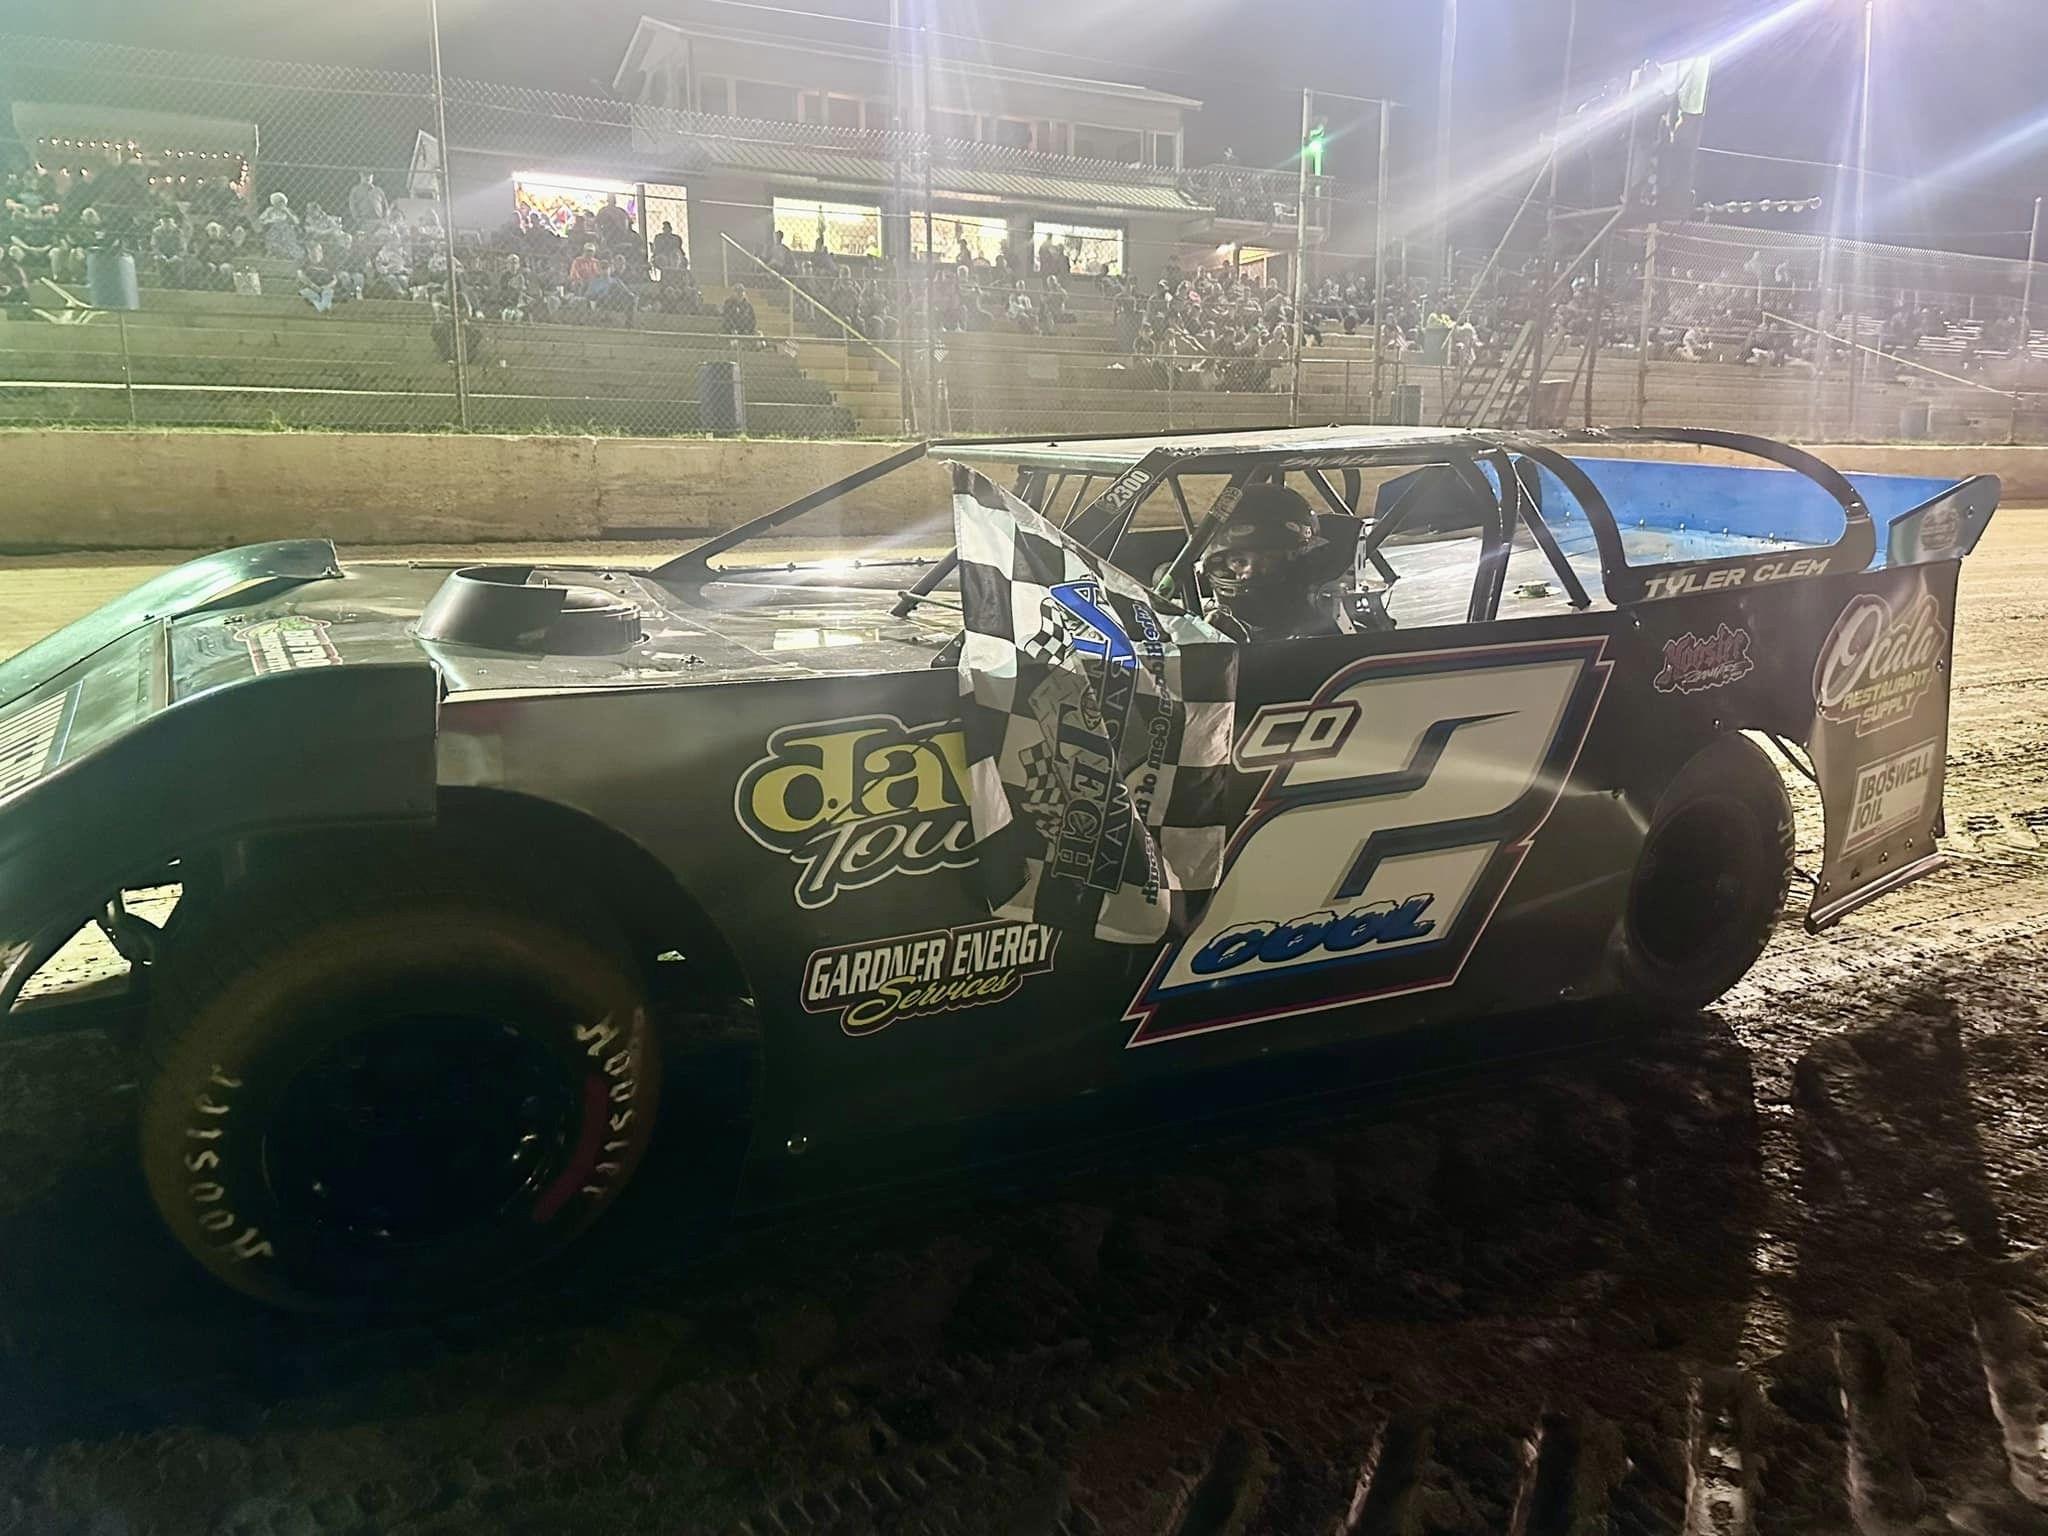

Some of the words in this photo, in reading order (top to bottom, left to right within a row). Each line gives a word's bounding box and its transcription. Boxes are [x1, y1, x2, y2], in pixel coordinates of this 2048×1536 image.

[1105, 469, 1151, 508] 2300
[1645, 568, 1747, 598] TYLER
[1752, 558, 1832, 583] CLEM
[1821, 602, 1937, 707] Ocala
[1841, 667, 1931, 712] RESTAURANT
[1861, 693, 1914, 725] SUPPLY
[1241, 705, 1356, 759] CO
[1864, 751, 1929, 802] BOSWELL
[1160, 659, 1585, 990] 2
[1858, 796, 1883, 829] OIL
[1190, 892, 1436, 976] COOL
[807, 937, 947, 1002] GARDNER
[951, 922, 1056, 976] ENERGY
[846, 967, 1017, 1027] Services
